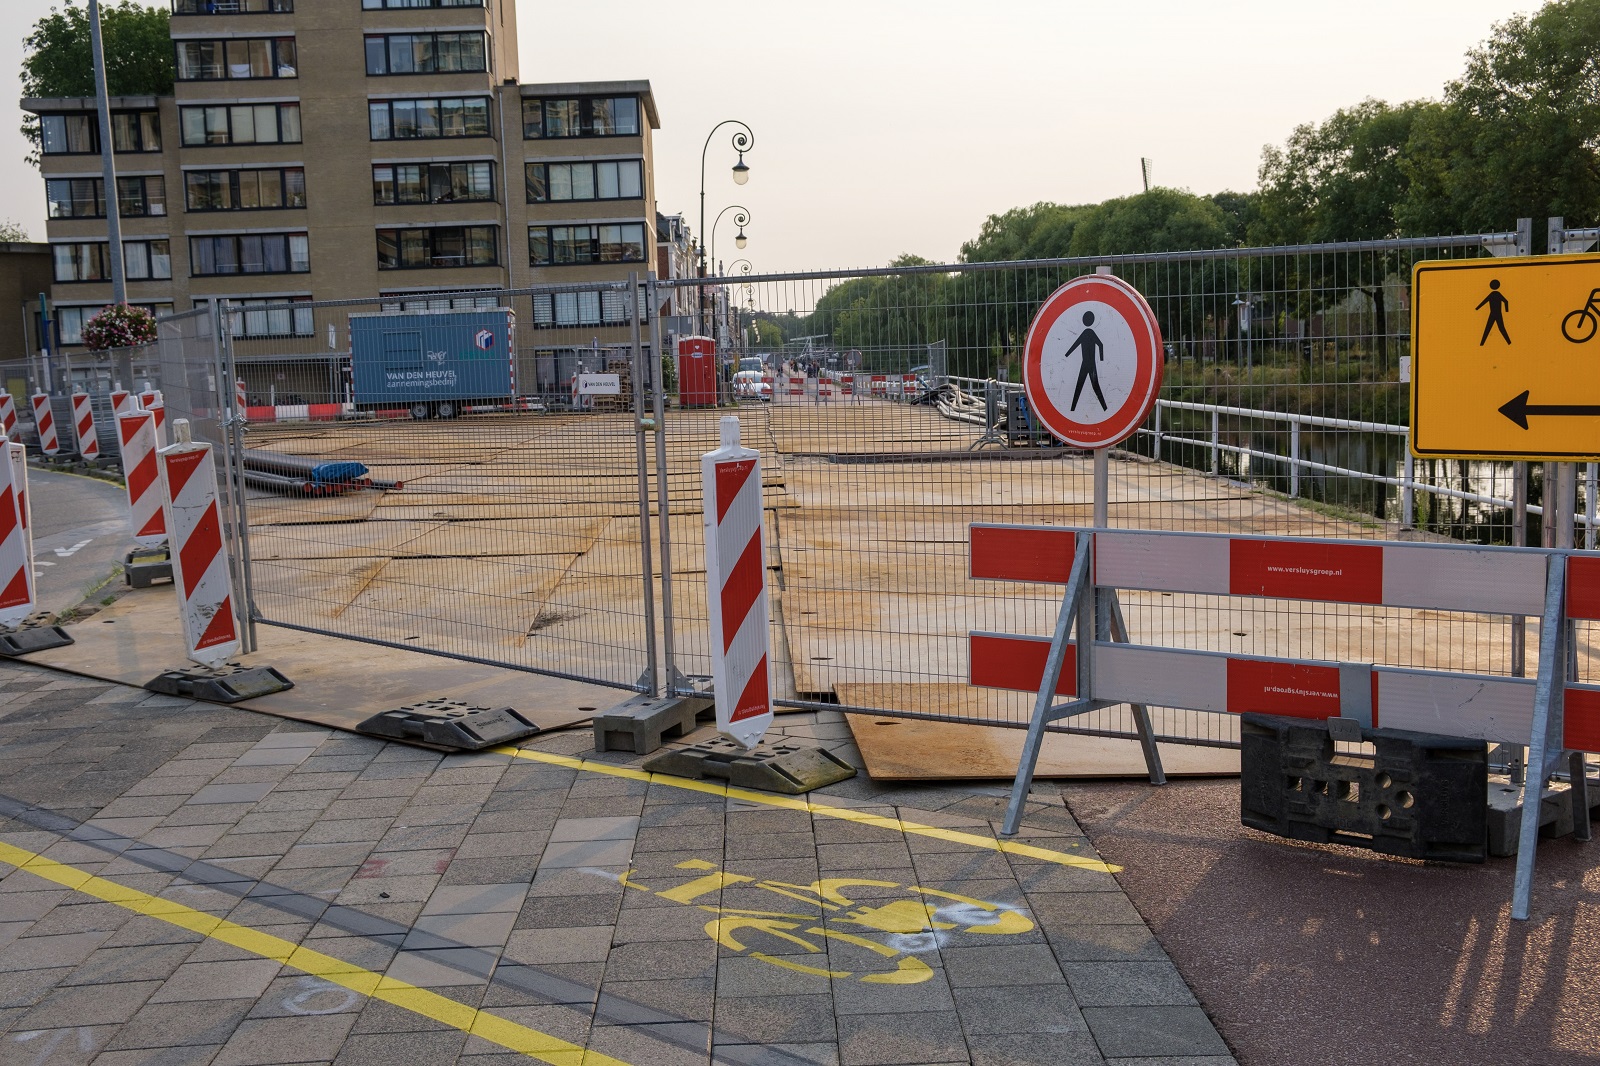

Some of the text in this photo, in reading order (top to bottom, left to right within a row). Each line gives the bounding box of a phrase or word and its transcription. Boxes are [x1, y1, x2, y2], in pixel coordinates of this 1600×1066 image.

[387, 370, 456, 380] VAN DEN HEUVEL
[1267, 566, 1343, 576] www.versluysgroep.nl
[1264, 686, 1339, 698] www.versluysgroep.nl
